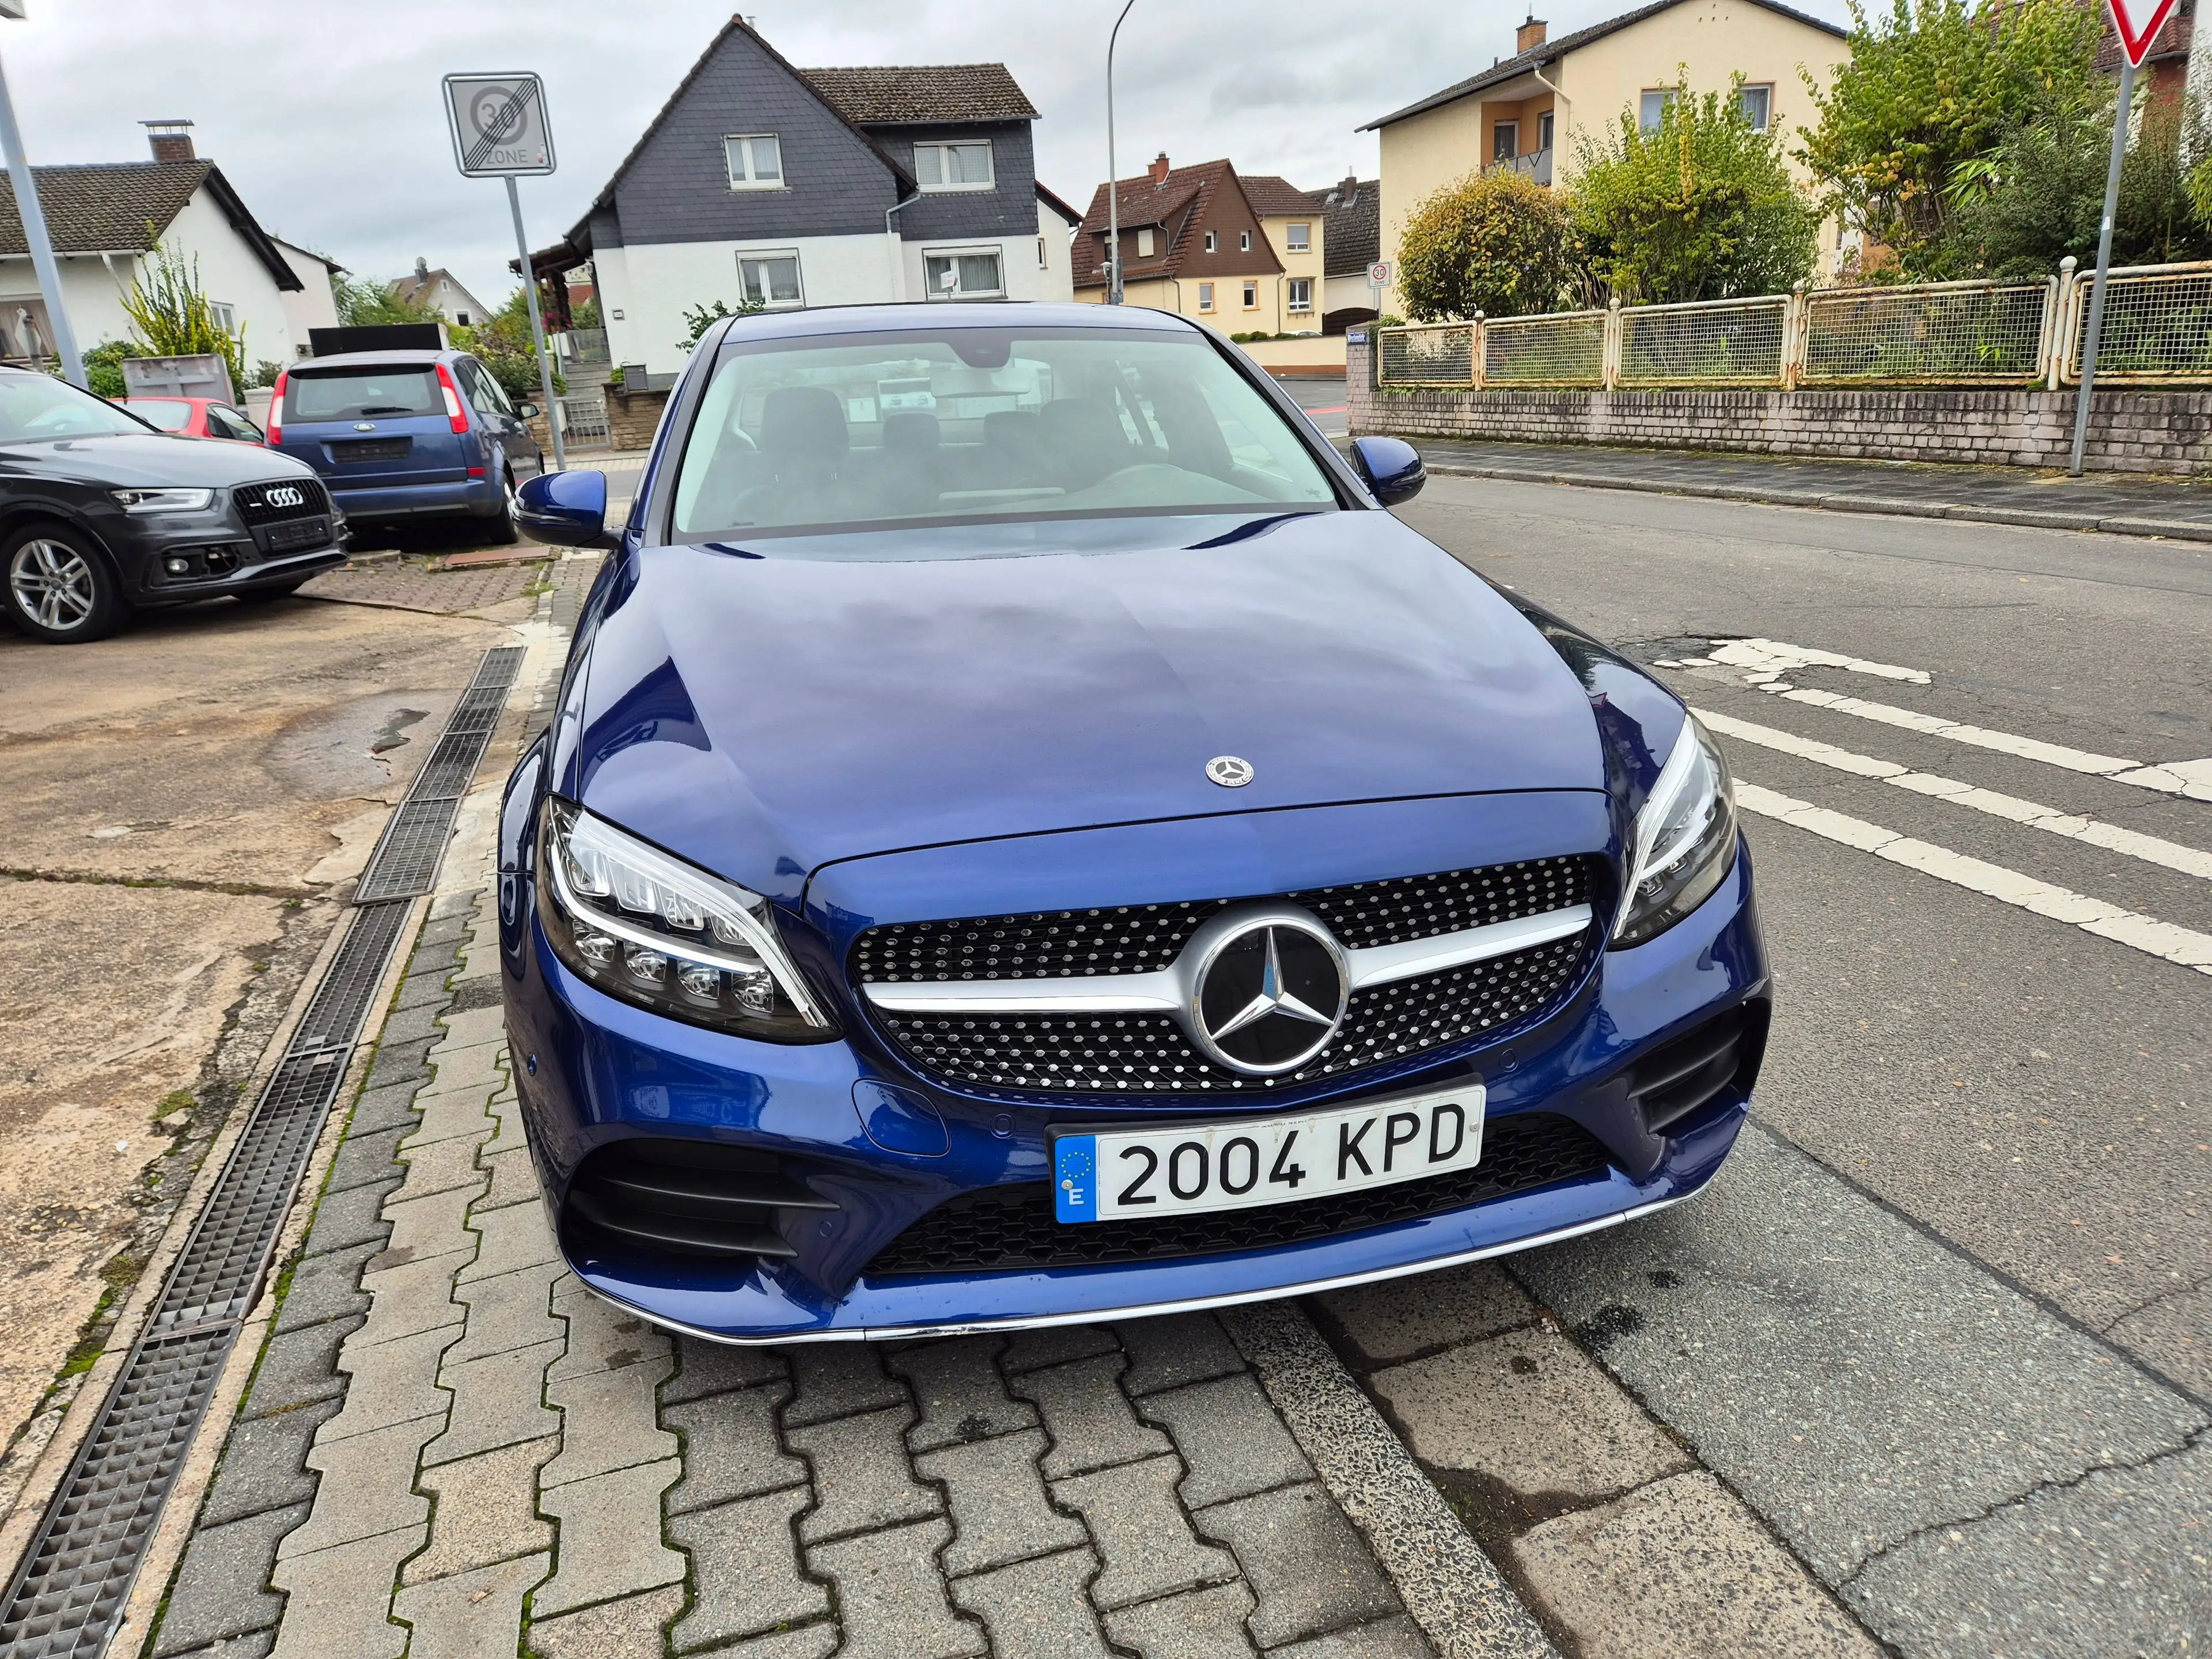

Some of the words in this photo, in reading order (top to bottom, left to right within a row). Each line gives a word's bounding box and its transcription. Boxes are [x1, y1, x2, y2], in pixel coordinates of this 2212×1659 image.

[482, 103, 516, 128] 30
[486, 149, 528, 164] ZONE
[1376, 268, 1384, 276] 30
[1118, 1131, 1305, 1205] 2004
[1337, 1103, 1465, 1180] KPD
[1069, 1188, 1084, 1205] E
